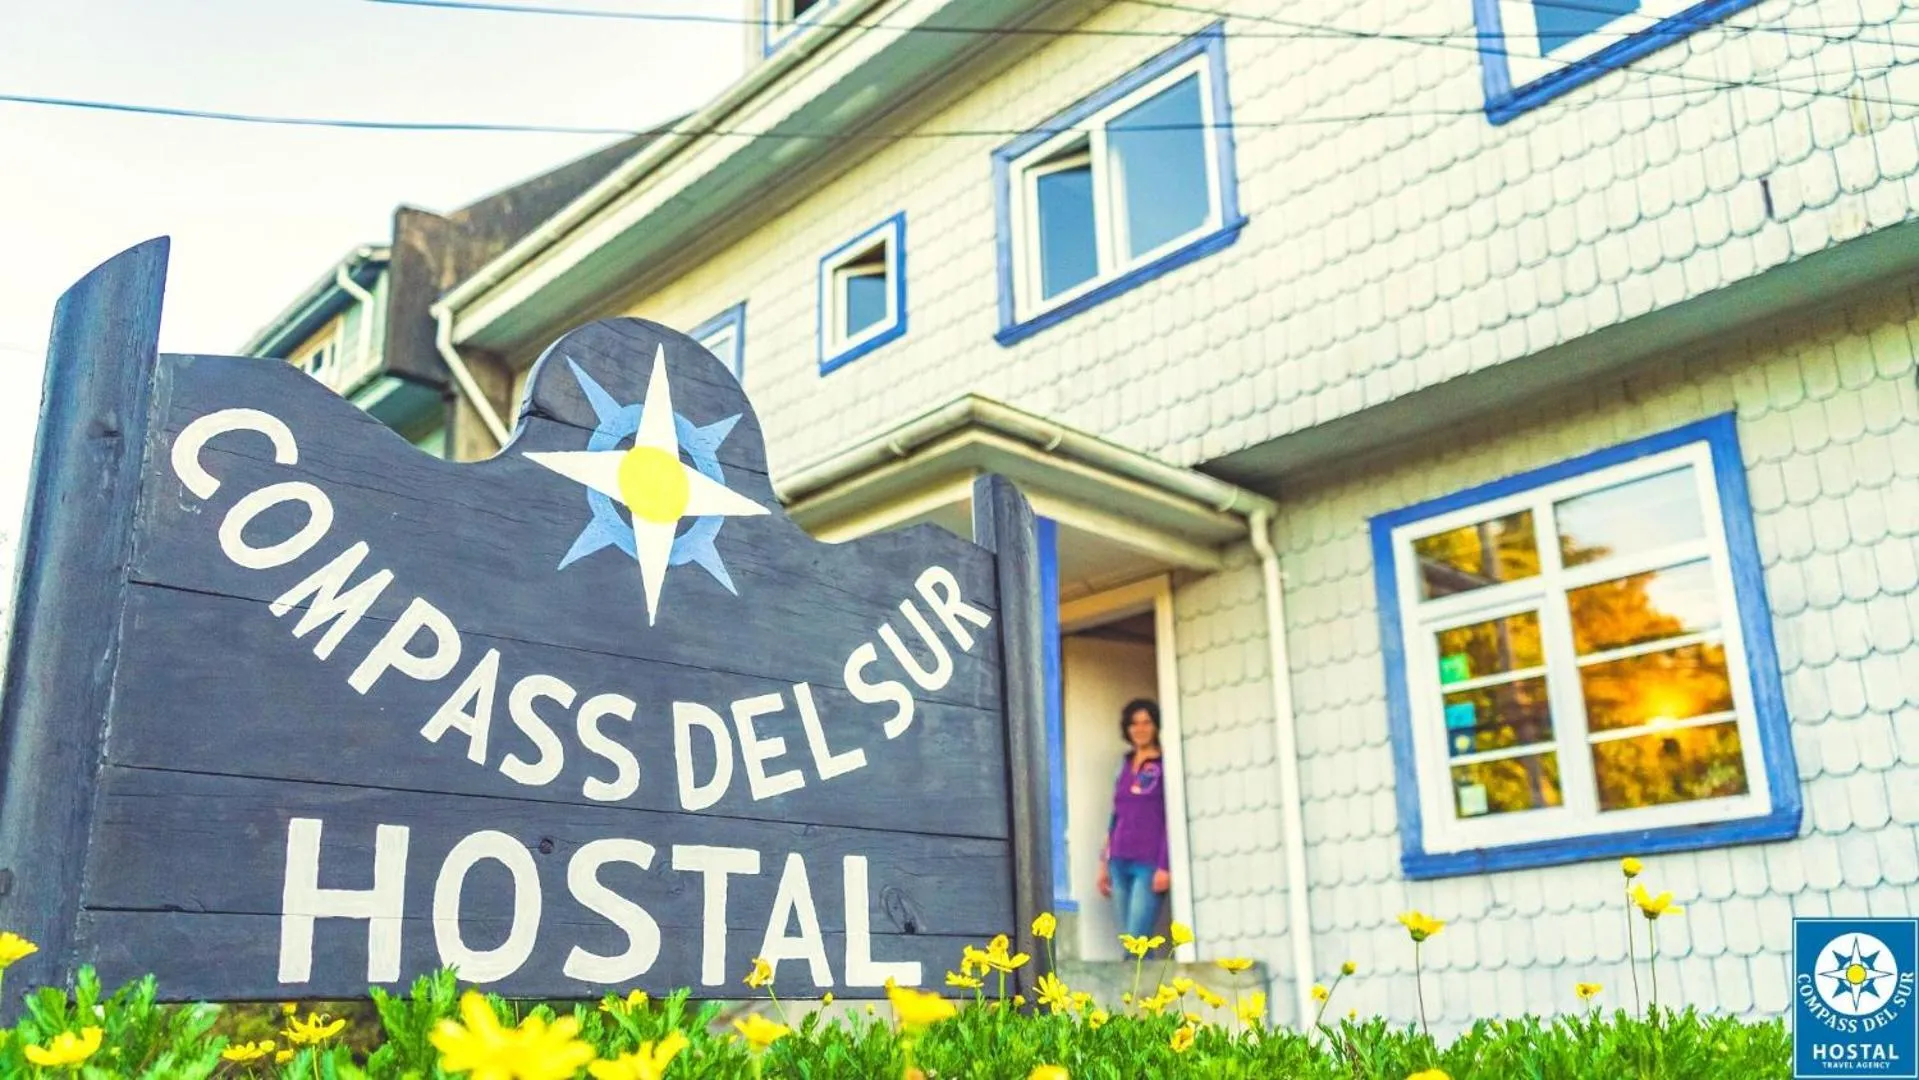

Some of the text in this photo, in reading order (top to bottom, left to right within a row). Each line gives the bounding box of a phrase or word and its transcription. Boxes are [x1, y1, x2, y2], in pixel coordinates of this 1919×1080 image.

[171, 407, 992, 811] COMPASS DEL SUR
[278, 817, 922, 988] HOSTAL
